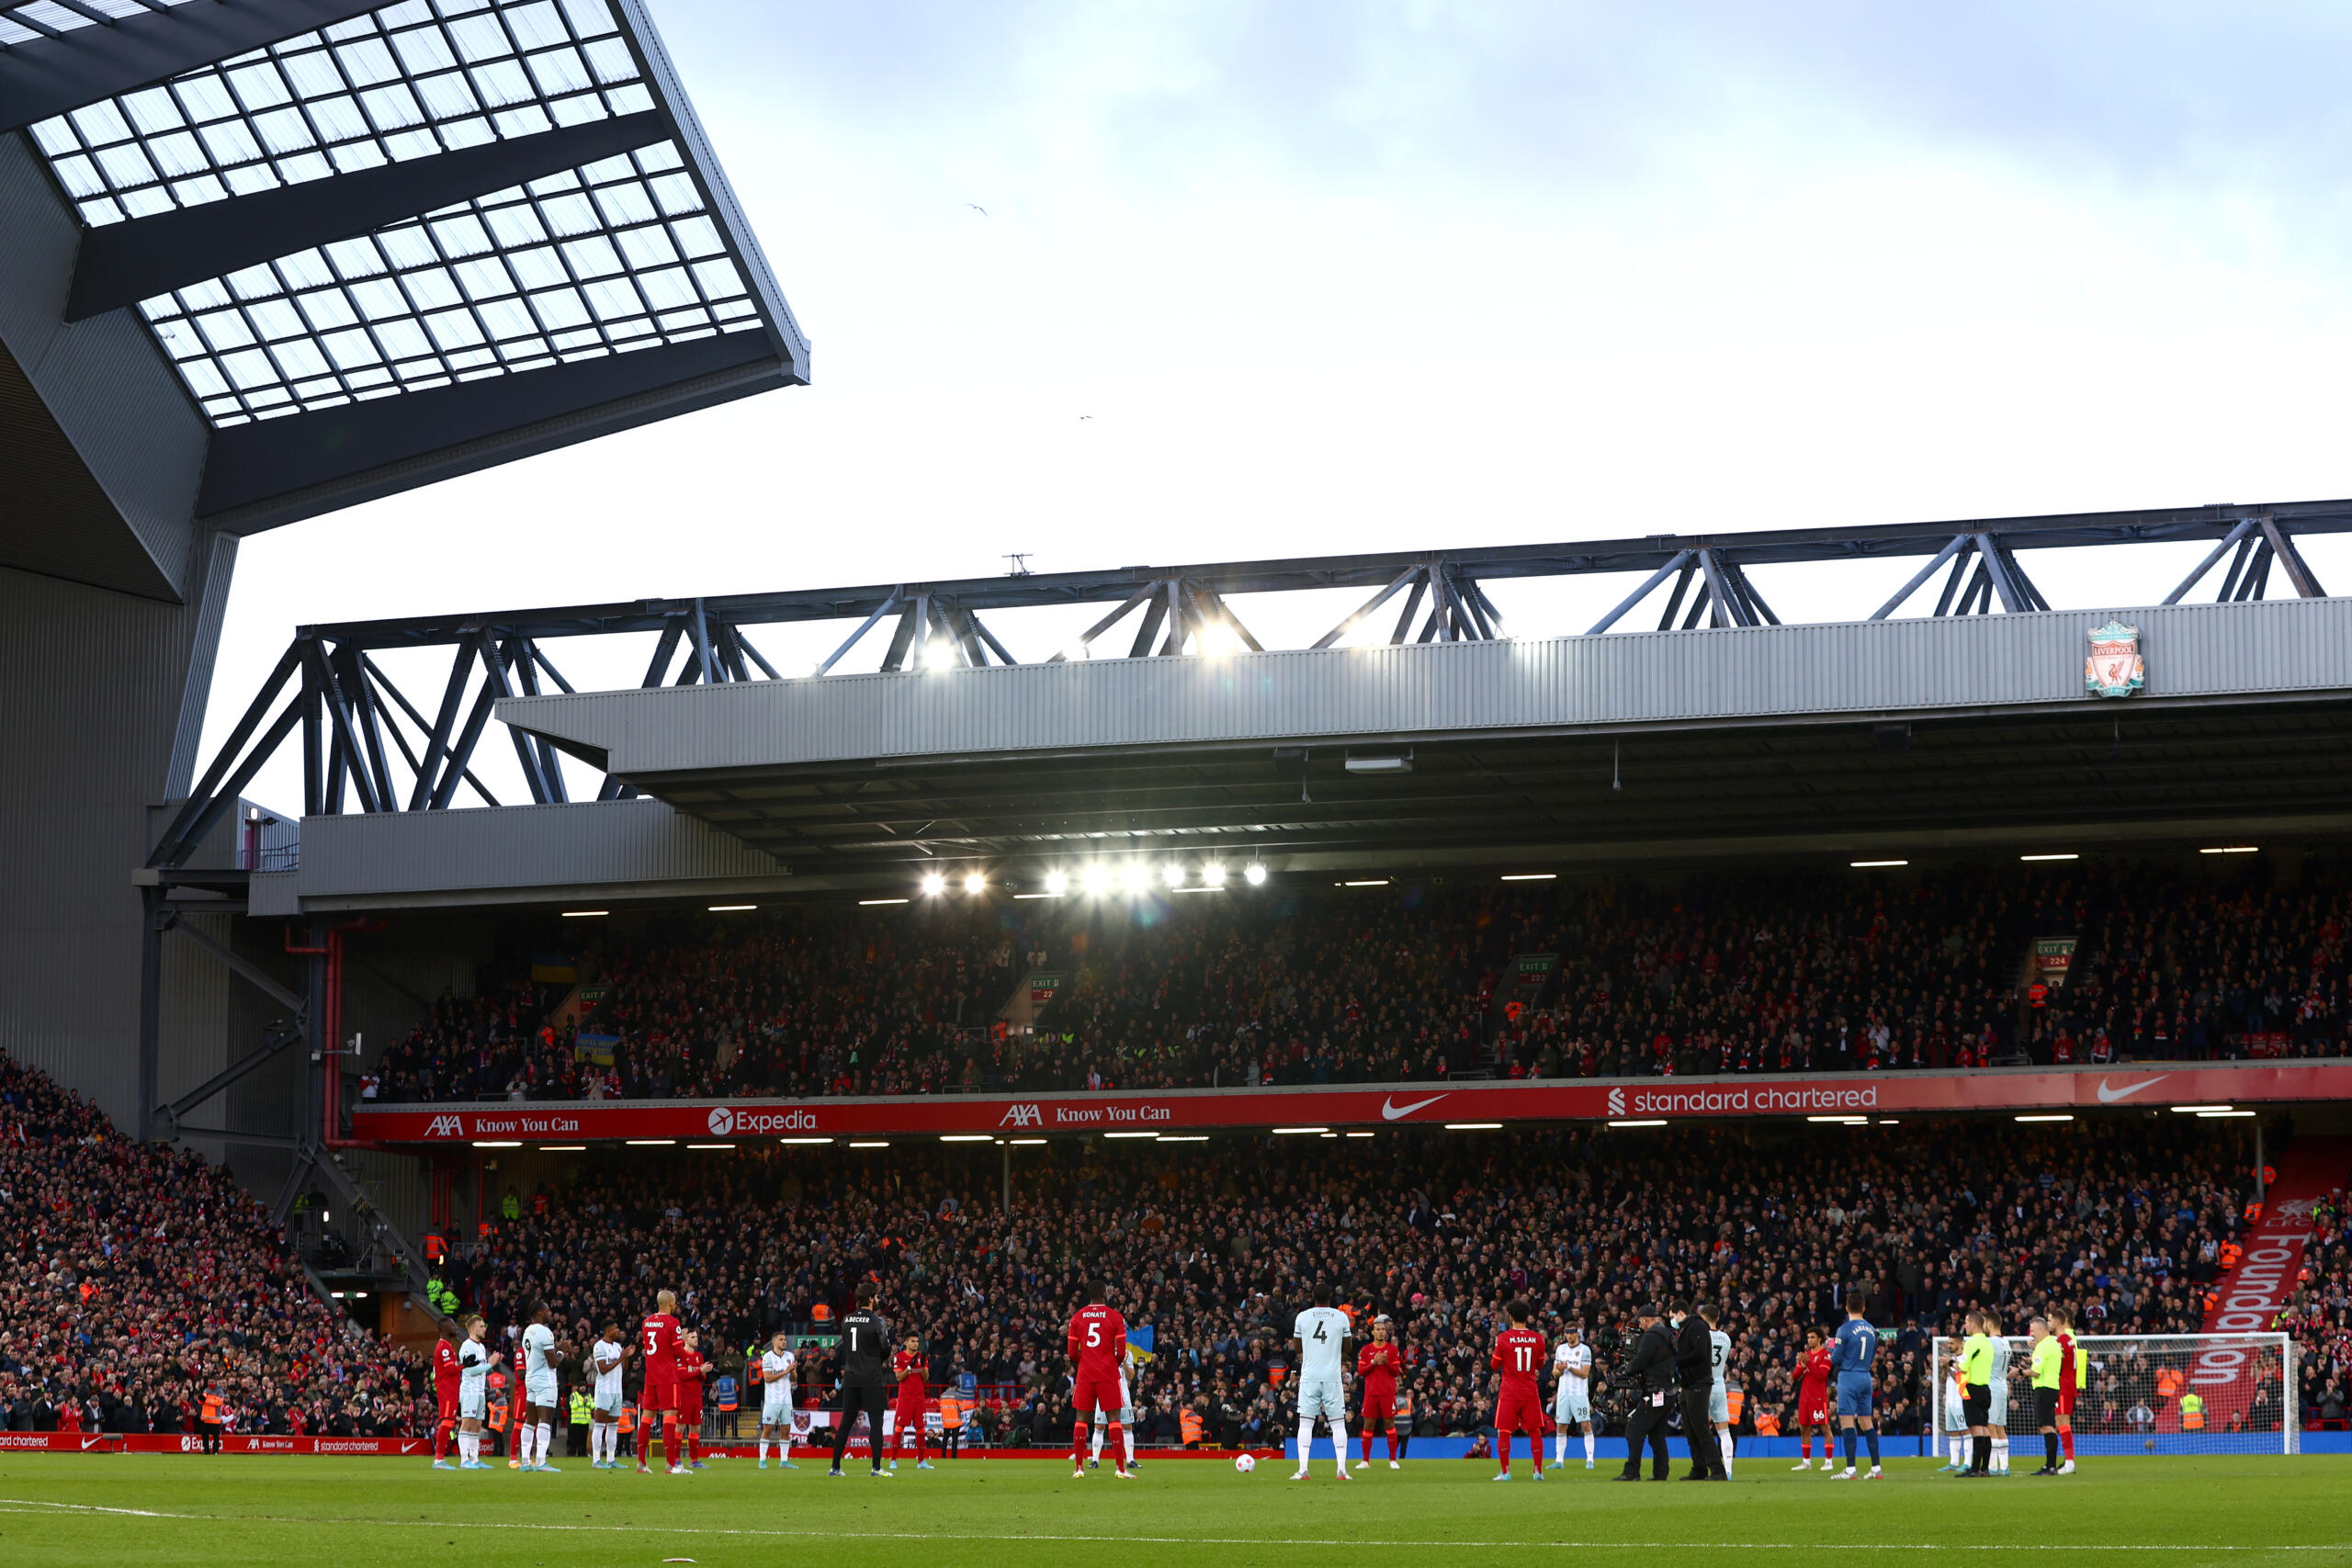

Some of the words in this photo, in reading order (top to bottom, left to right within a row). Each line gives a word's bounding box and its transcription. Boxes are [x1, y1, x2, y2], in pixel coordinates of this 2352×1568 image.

[2094, 647, 2133, 655] LIVERPOOL
[2050, 957, 2065, 965] 224
[1032, 979, 1052, 987] EXIT
[1634, 1089, 1748, 1112] standard
[1754, 1086, 1877, 1109] chartered
[424, 1115, 464, 1136] AXA
[476, 1119, 517, 1133] Know
[521, 1117, 548, 1132] You
[551, 1117, 580, 1132] Can
[736, 1110, 817, 1134] Expedia
[999, 1104, 1043, 1127] AXA
[1057, 1108, 1102, 1122] Know
[1106, 1106, 1136, 1122] You
[1140, 1105, 1170, 1121] Can
[646, 1331, 658, 1356] 3
[850, 1327, 857, 1352] 1
[1086, 1323, 1101, 1348] 5
[1313, 1321, 1328, 1345] 4
[525, 1338, 532, 1359] 9
[1514, 1347, 1532, 1371] 11
[1860, 1337, 1867, 1360] 1
[1577, 1407, 1588, 1416] 28
[1814, 1410, 1825, 1419] 66
[1956, 1415, 1965, 1424] 10
[13, 1436, 49, 1447] chartered
[246, 1438, 260, 1450] AXA
[320, 1440, 348, 1451] standard
[349, 1440, 379, 1451] chartered
